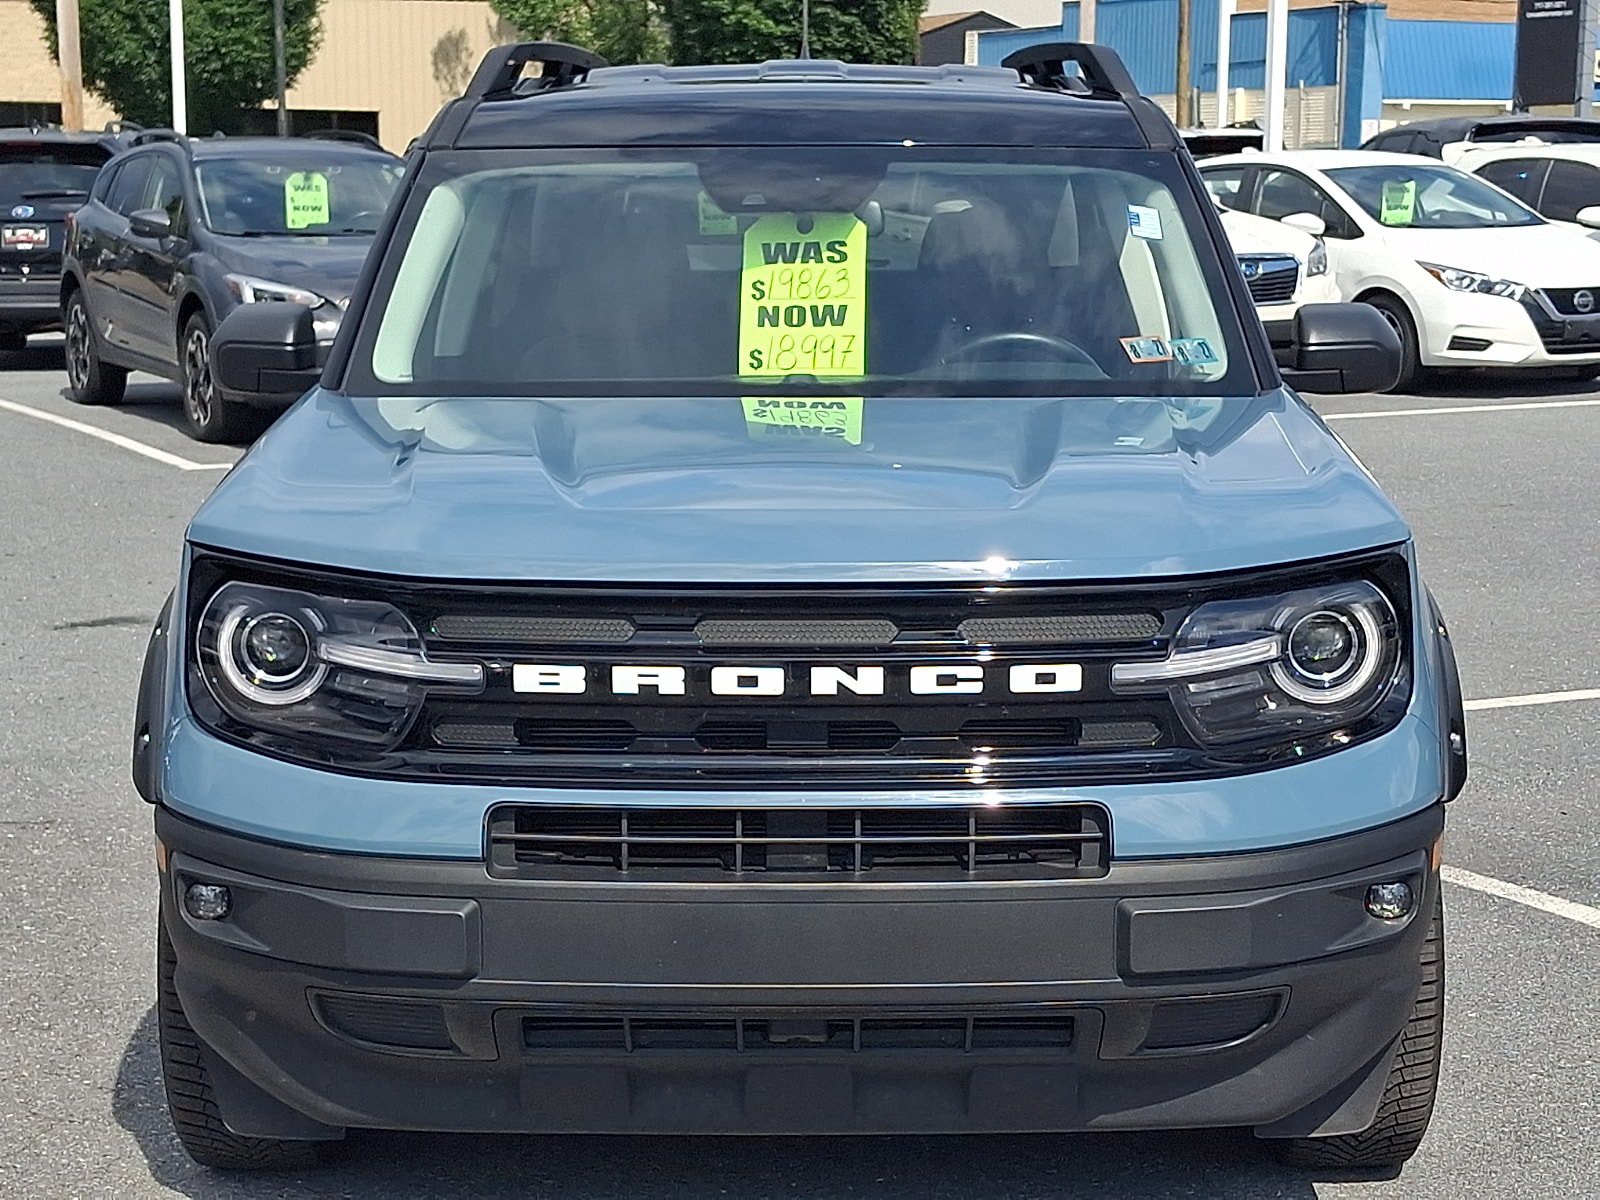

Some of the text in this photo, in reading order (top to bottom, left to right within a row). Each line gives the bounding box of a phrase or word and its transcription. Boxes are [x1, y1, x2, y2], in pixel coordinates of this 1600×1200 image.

[761, 240, 848, 265] WAS
[751, 268, 850, 301] $19863
[757, 304, 848, 328] NOW
[748, 334, 856, 370] $18997
[511, 663, 1083, 695] BRONCO
